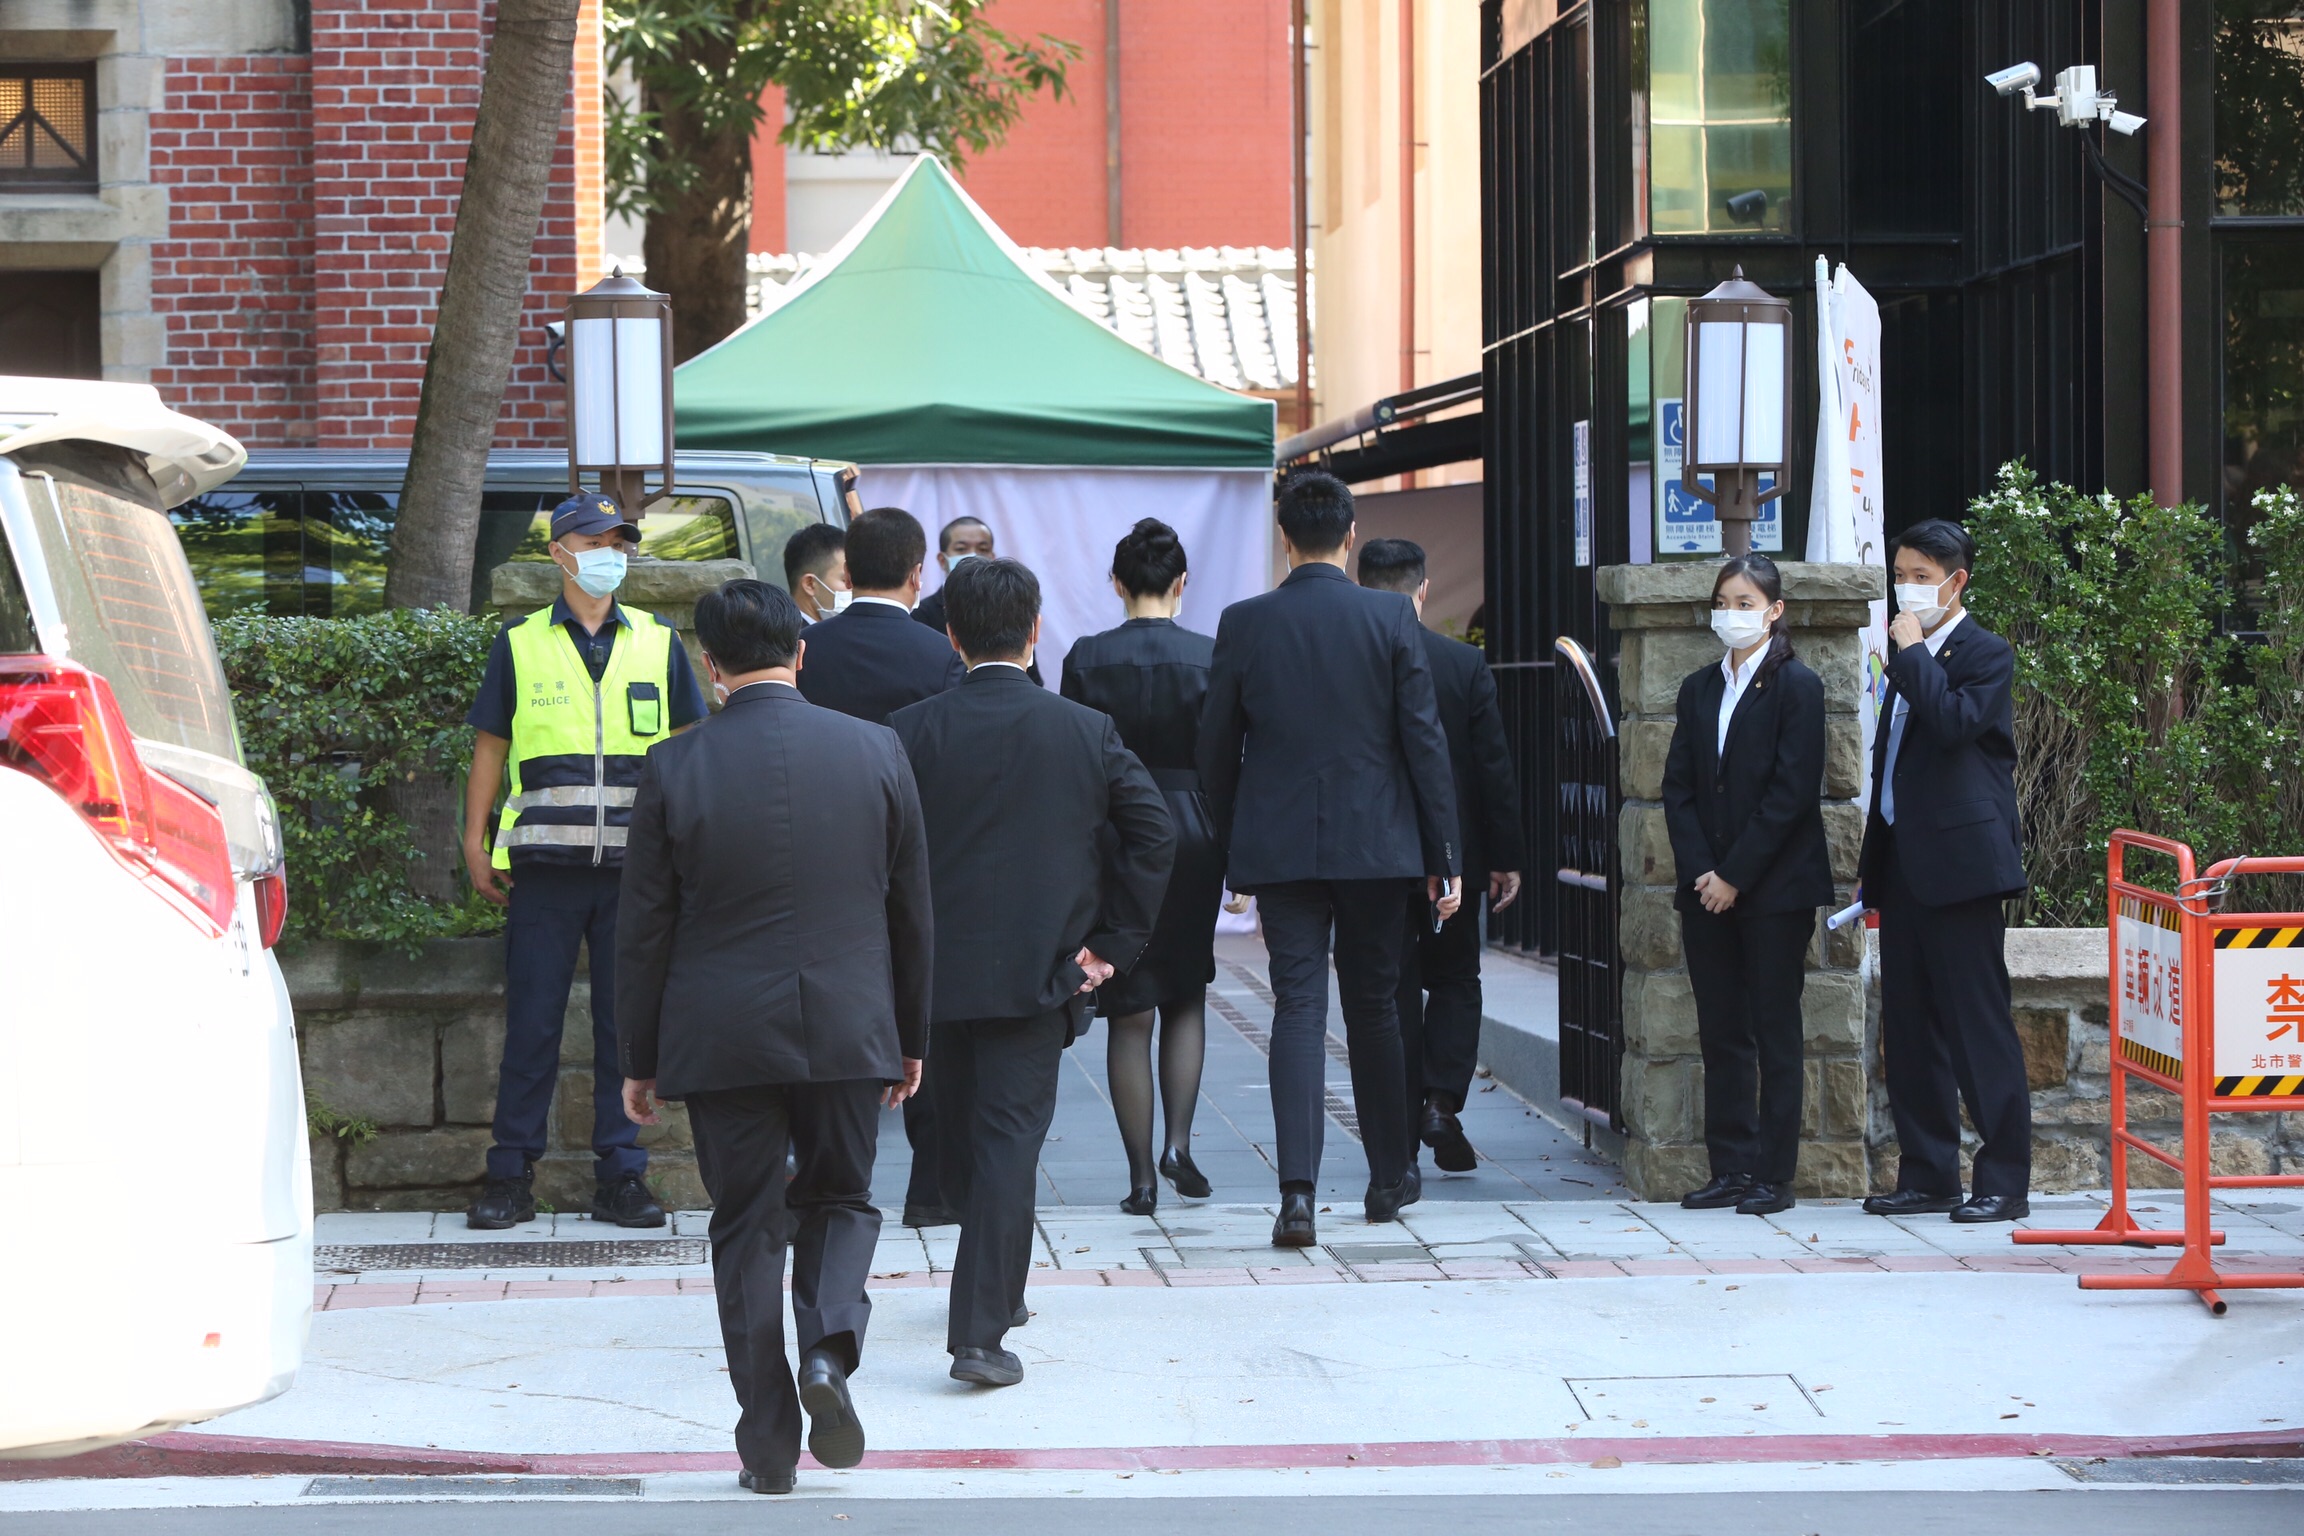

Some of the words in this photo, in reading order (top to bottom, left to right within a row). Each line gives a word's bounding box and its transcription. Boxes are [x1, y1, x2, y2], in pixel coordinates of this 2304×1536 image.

[531, 696, 570, 707] POLICE
[2125, 943, 2181, 1026] 車輛改道
[2251, 1054, 2303, 1069] 北市警
